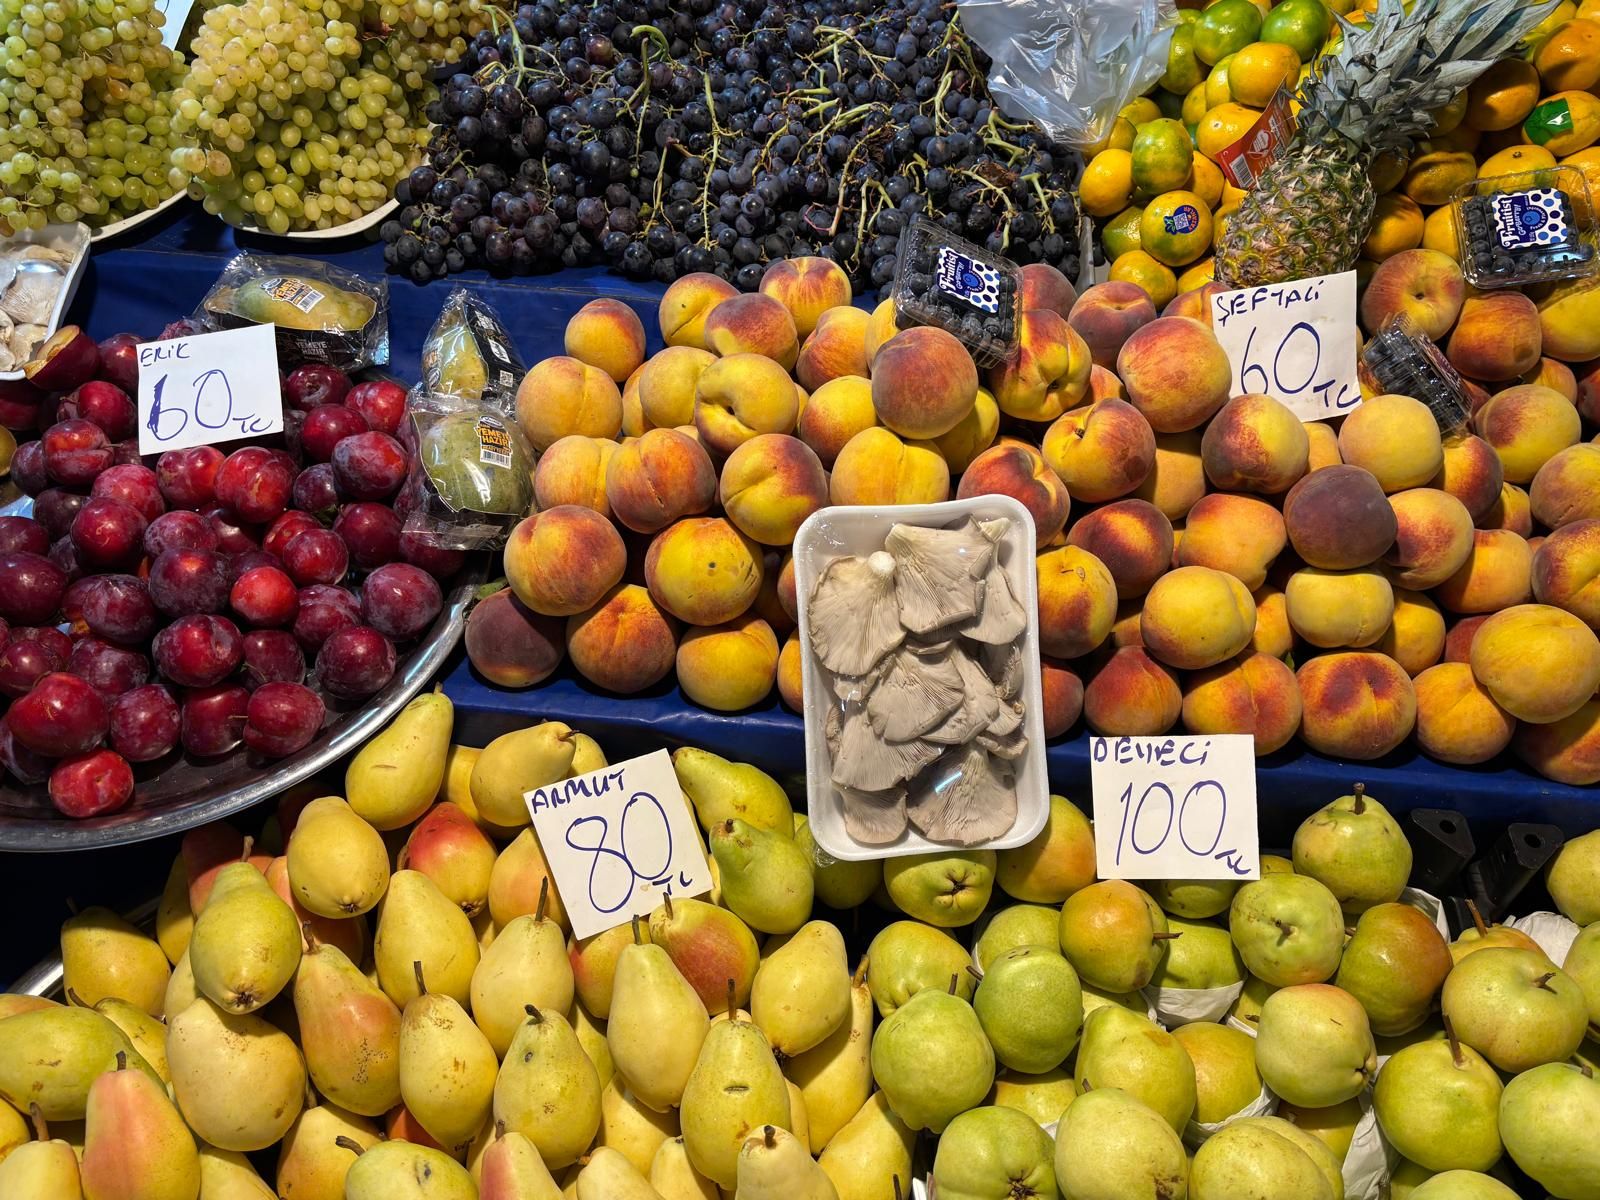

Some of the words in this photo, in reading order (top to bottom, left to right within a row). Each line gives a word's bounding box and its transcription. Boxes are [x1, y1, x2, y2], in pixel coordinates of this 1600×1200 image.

[1500, 198, 1520, 248] Fruitist
[939, 252, 958, 291] Fruitist
[1241, 321, 1320, 395] 60
[147, 369, 232, 441] 60
[532, 768, 625, 814] ARMUT
[1116, 780, 1227, 866] 100
[565, 791, 672, 913] 80
